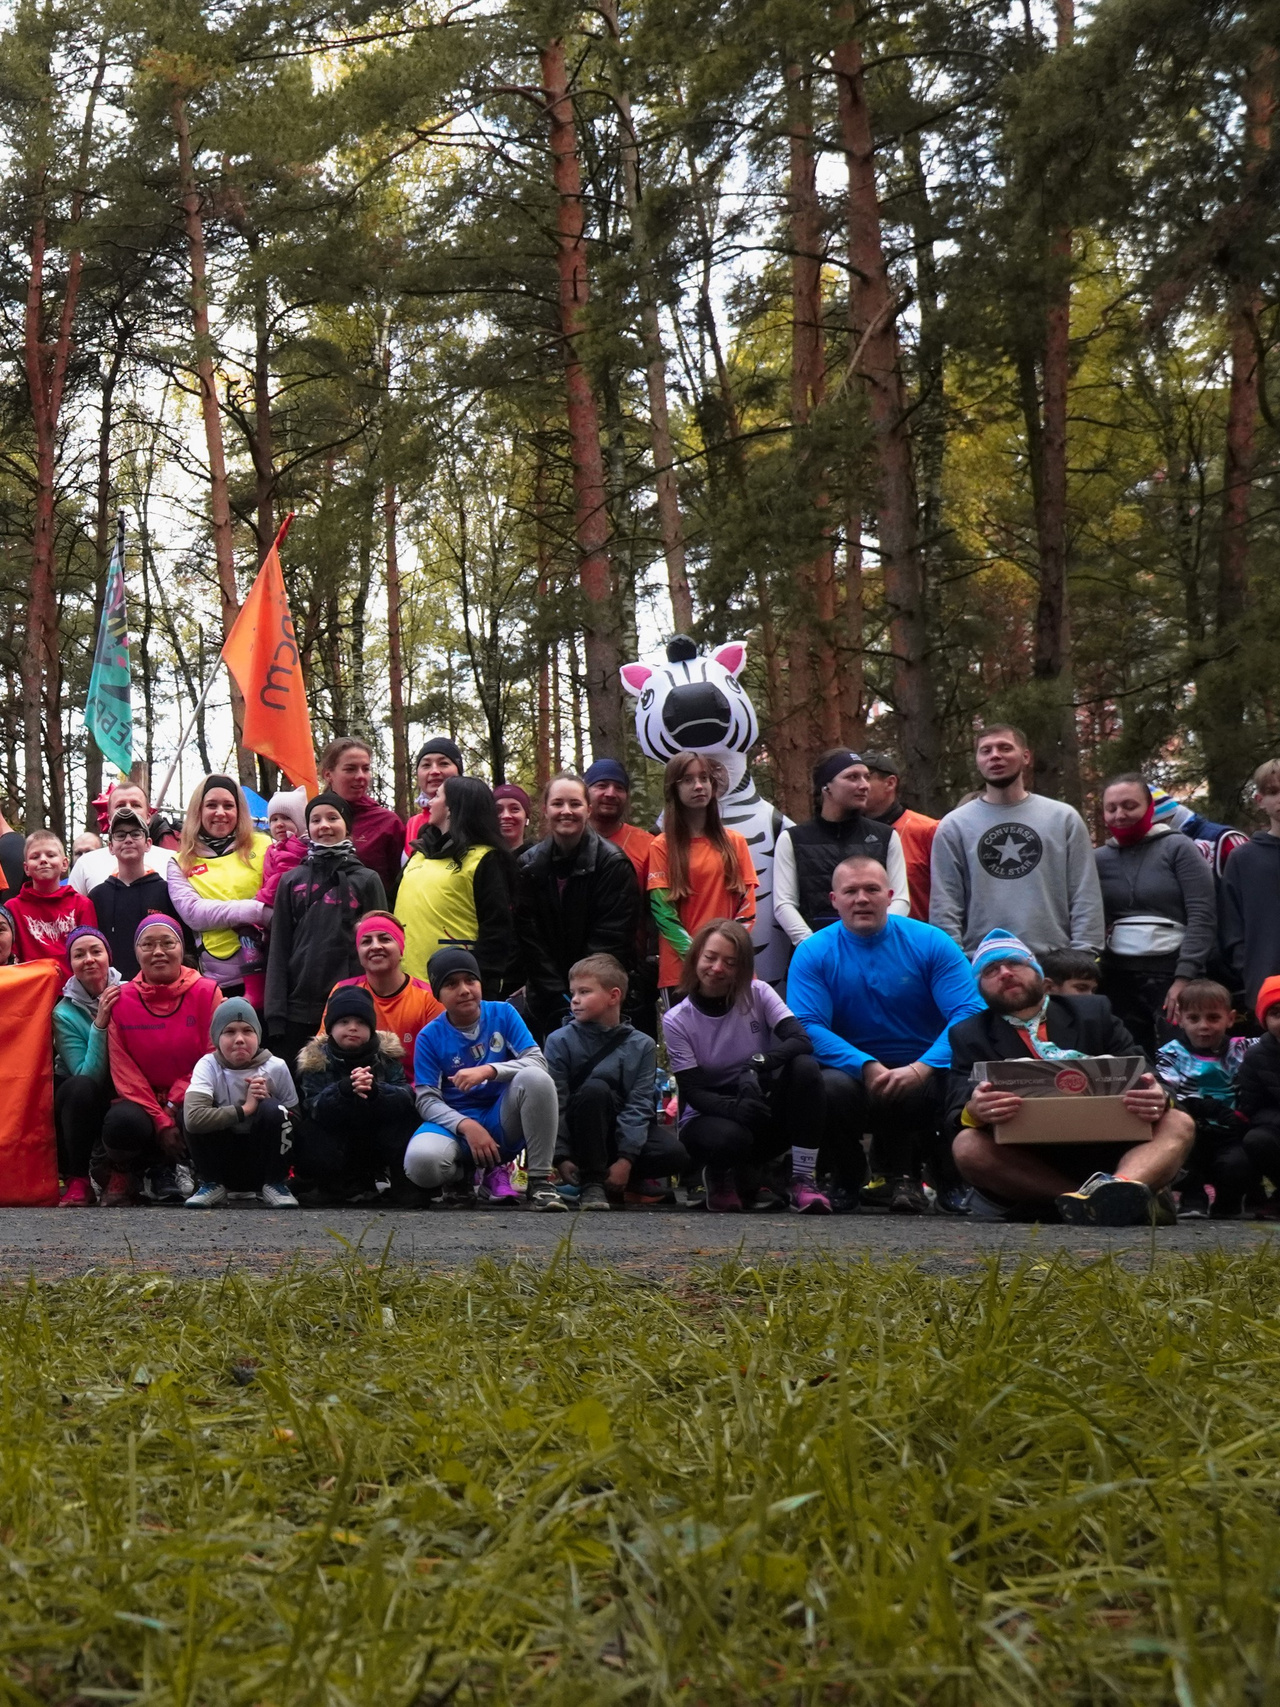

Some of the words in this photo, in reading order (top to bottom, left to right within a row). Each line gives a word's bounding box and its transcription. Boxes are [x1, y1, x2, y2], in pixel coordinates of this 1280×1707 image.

[983, 826, 1035, 846] CONVERSE
[988, 863, 1006, 876] ALL
[1007, 860, 1033, 876] STAR
